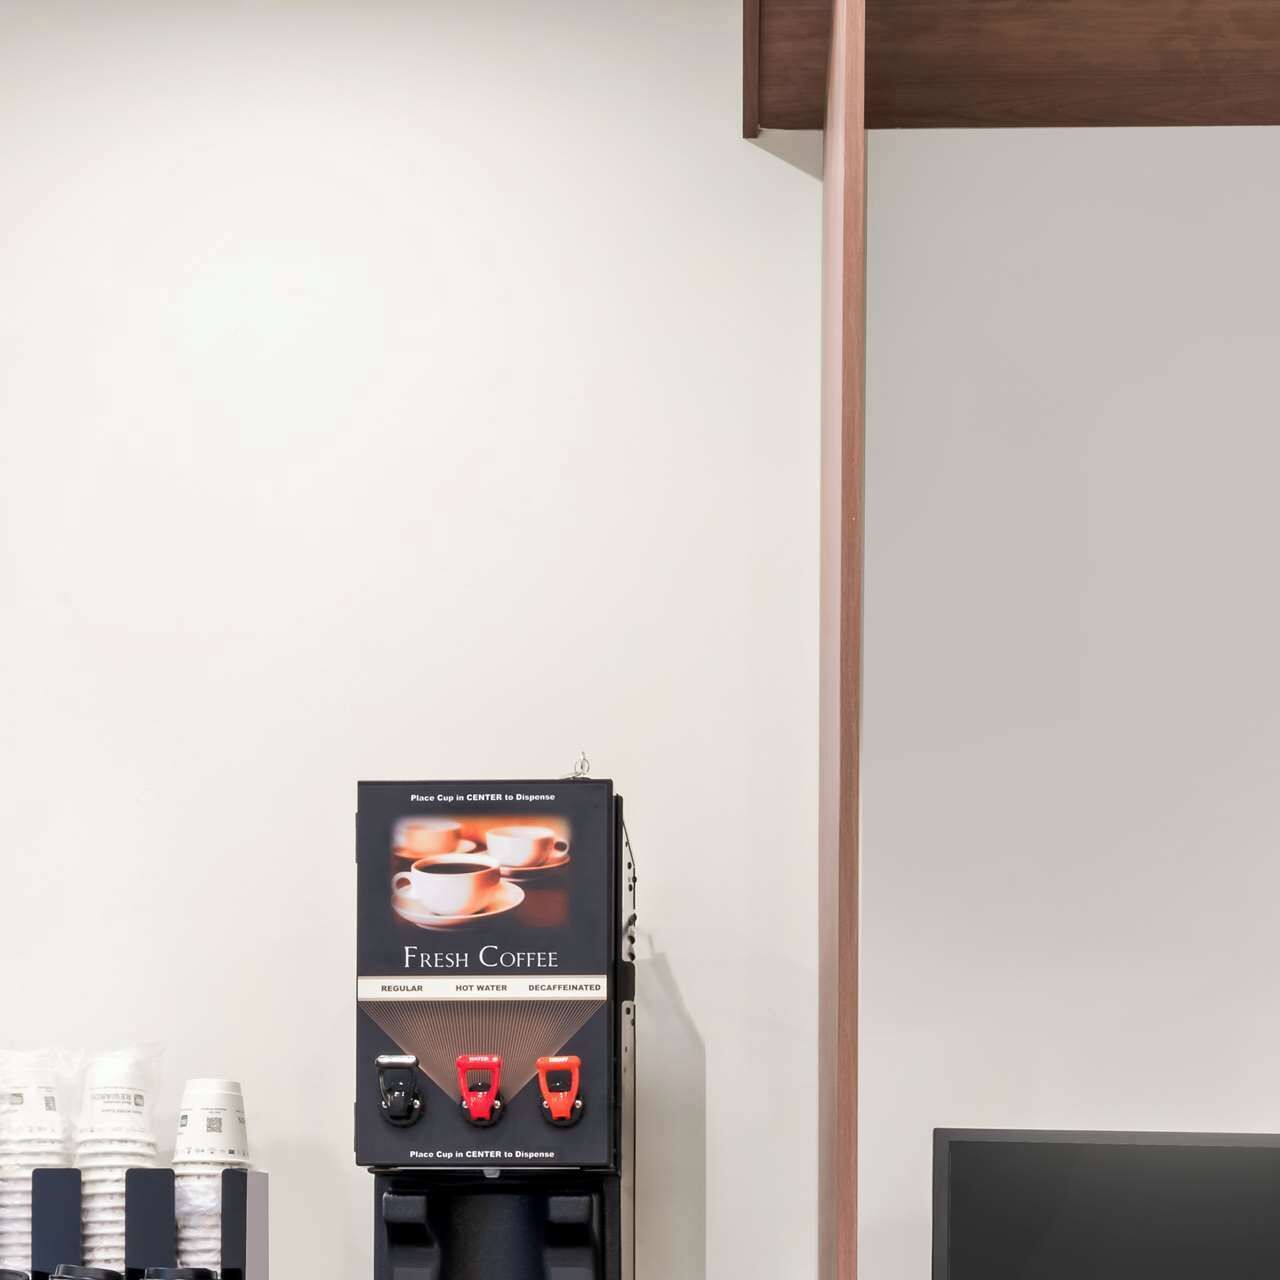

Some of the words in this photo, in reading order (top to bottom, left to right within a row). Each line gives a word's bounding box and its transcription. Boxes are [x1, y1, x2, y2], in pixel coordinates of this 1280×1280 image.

[410, 794, 435, 802] Place
[437, 794, 454, 803] Cup
[456, 794, 464, 802] in
[466, 793, 503, 802] CENTER
[505, 794, 514, 802] to
[516, 793, 556, 803] Dispense
[404, 945, 469, 968] FRESH
[479, 945, 559, 968] COFFEE
[381, 984, 423, 992] REGULAR
[455, 984, 474, 992] HOT
[476, 984, 508, 992] WATER
[528, 984, 601, 992] DECAFFEINATED
[409, 1150, 434, 1158] Place
[436, 1150, 454, 1160] Cup
[455, 1150, 464, 1158] in
[465, 1150, 502, 1158] CENTER
[503, 1150, 513, 1158] to
[515, 1150, 555, 1160] Dispense
